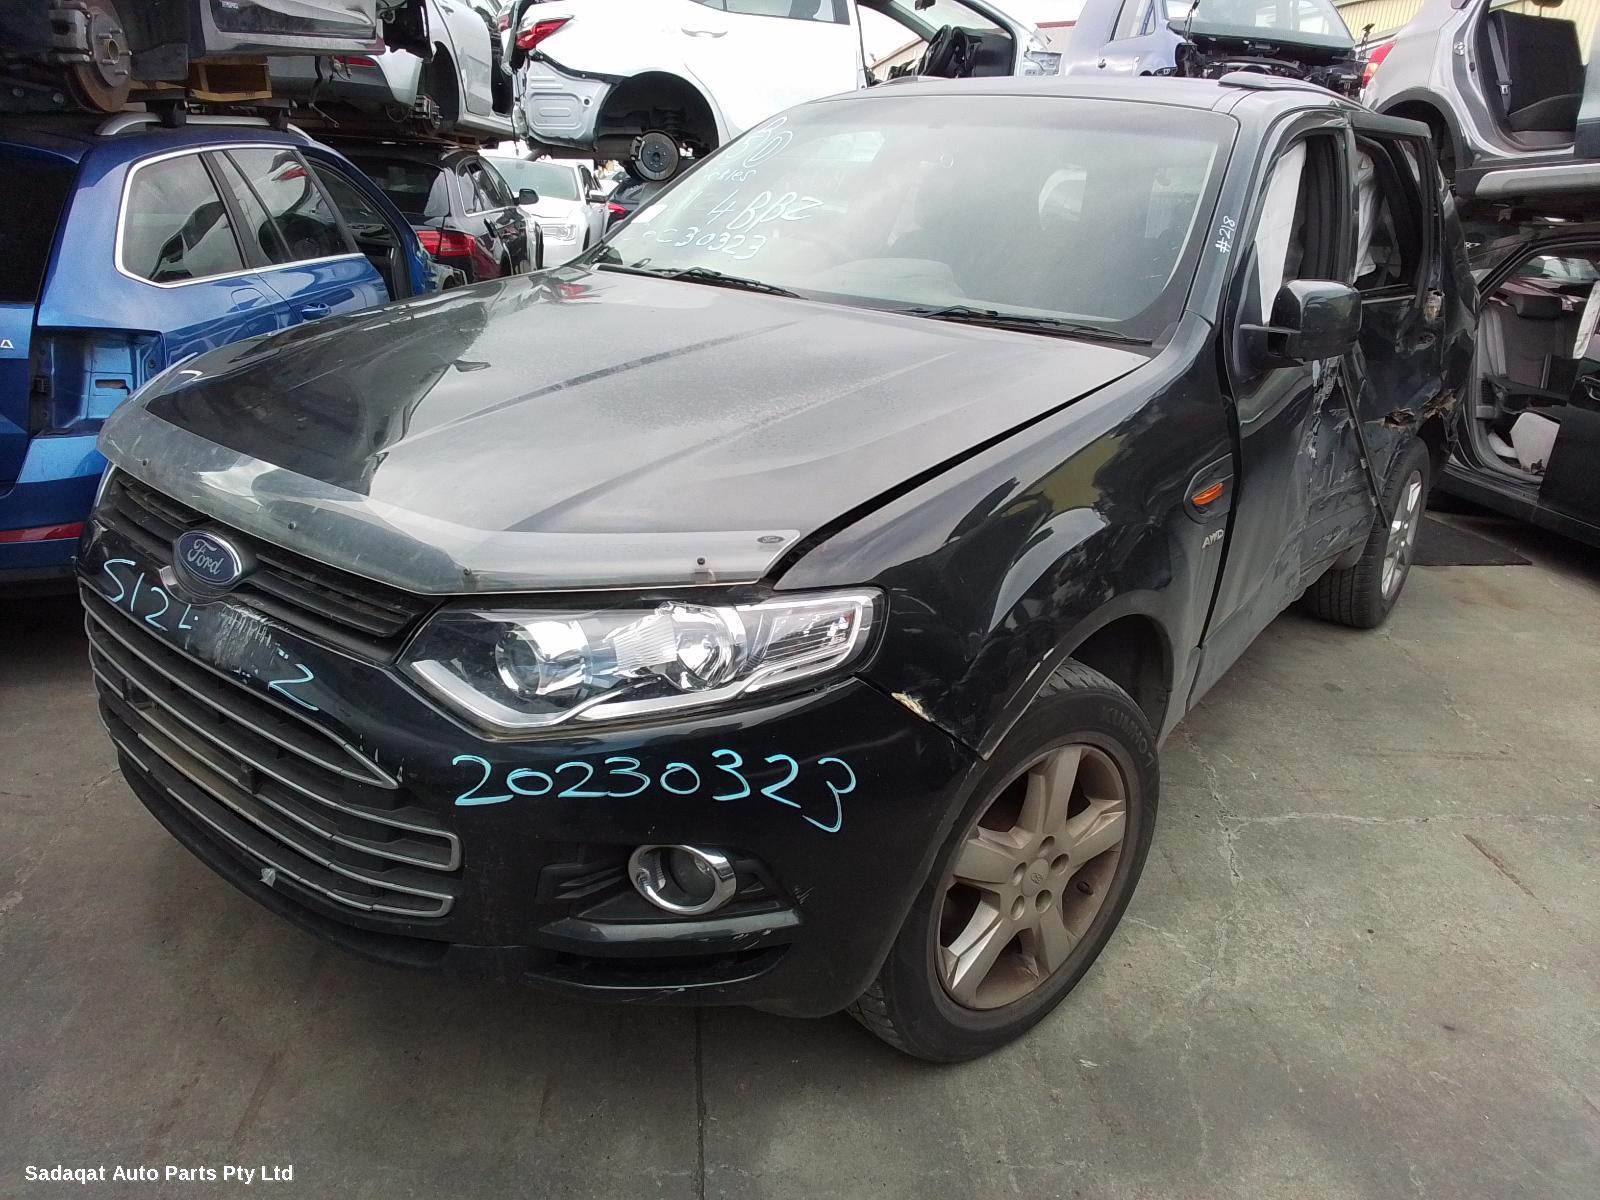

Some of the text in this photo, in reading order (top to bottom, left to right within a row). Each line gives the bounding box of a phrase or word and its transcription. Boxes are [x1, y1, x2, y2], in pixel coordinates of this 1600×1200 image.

[186, 538, 224, 576] Ford
[1201, 529, 1225, 549] AWD
[451, 748, 857, 833] 20230323
